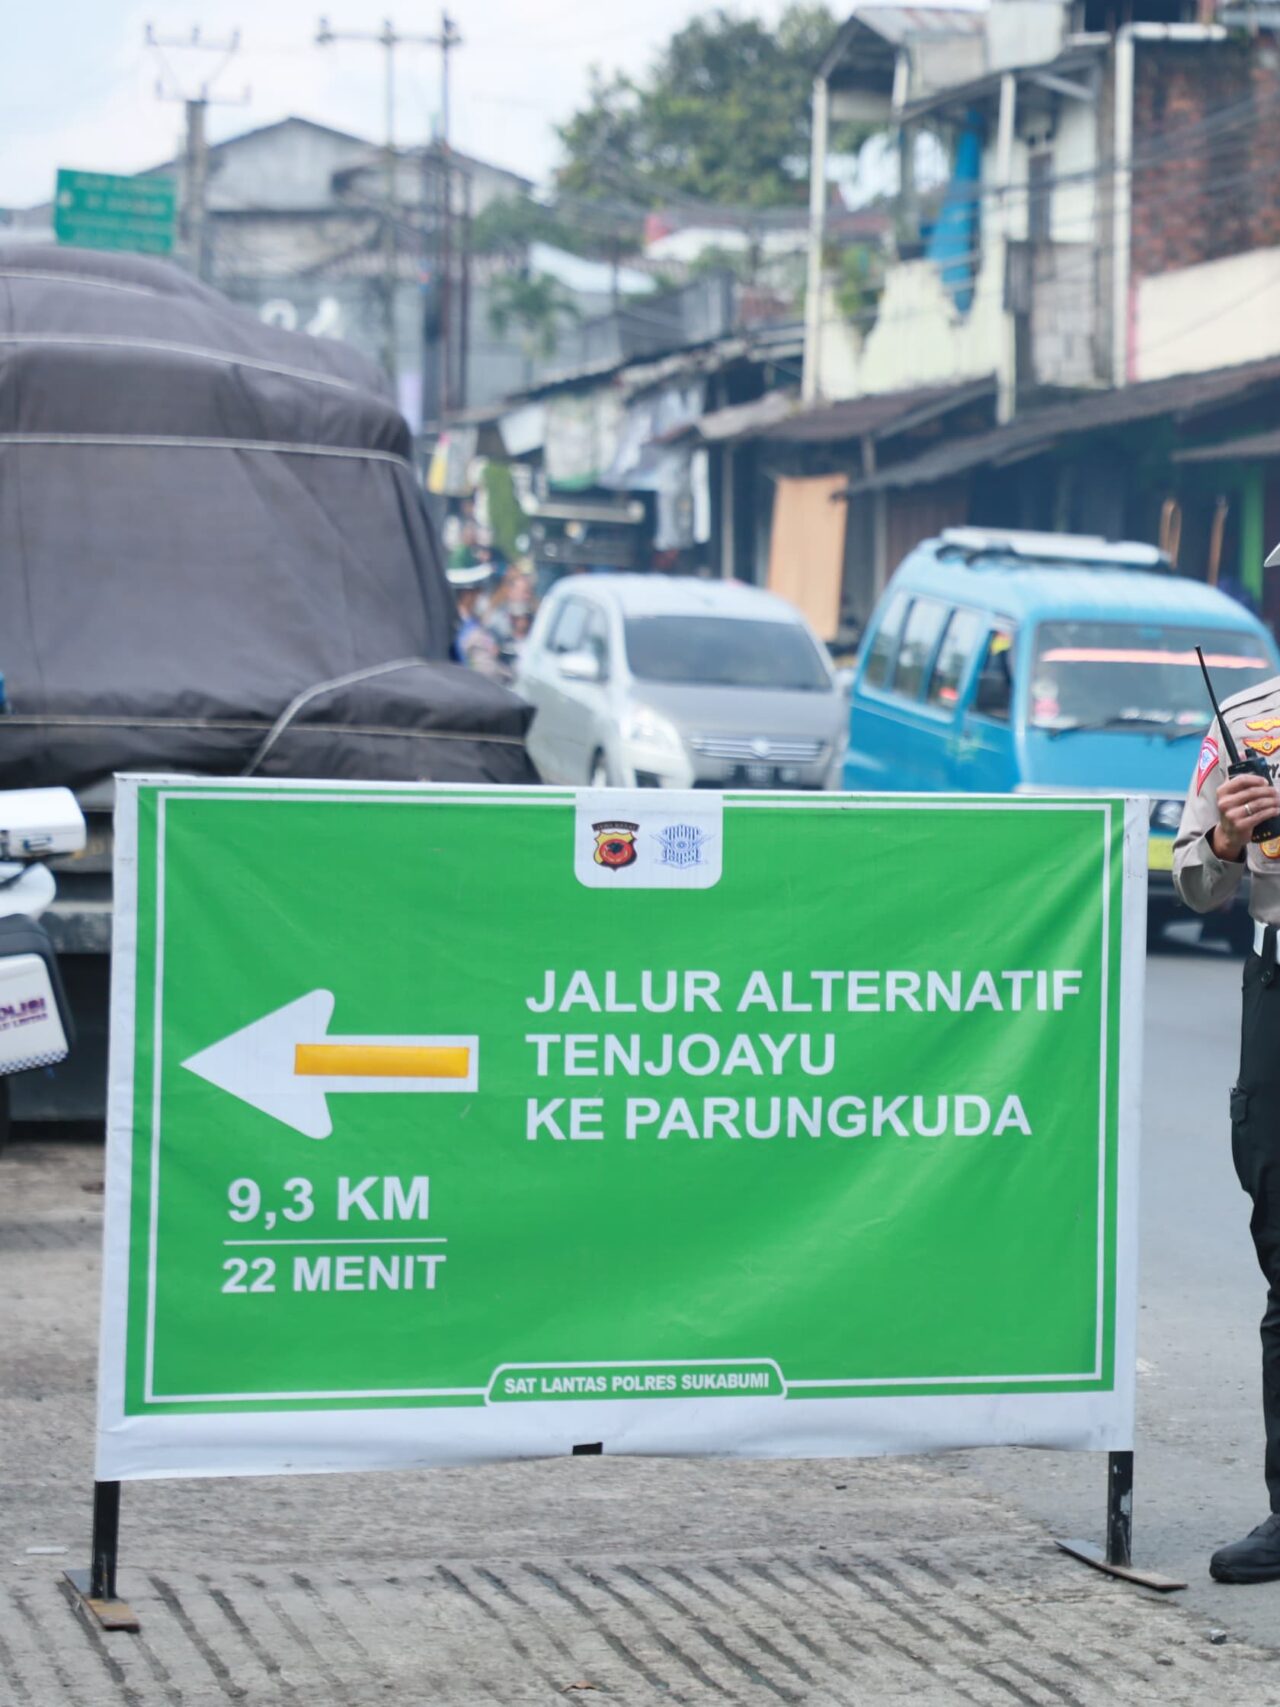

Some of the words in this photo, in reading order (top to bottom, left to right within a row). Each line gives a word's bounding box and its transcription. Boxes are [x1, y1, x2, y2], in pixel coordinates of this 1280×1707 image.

[526, 970, 722, 1013] JALUR
[738, 970, 1082, 1012] ALTERNATIF
[525, 1033, 835, 1076] TENJOAYU
[526, 1097, 604, 1140] KE
[626, 1094, 1032, 1140] PARUNGKUDA
[228, 1177, 315, 1230] 9,3
[337, 1176, 429, 1221] KM
[222, 1257, 276, 1293] 22
[293, 1255, 447, 1292] MENIT
[505, 1377, 536, 1394] SAT
[541, 1376, 607, 1393] LANTAS
[612, 1375, 676, 1392] POLRES
[682, 1373, 769, 1390] SUKABUMI
